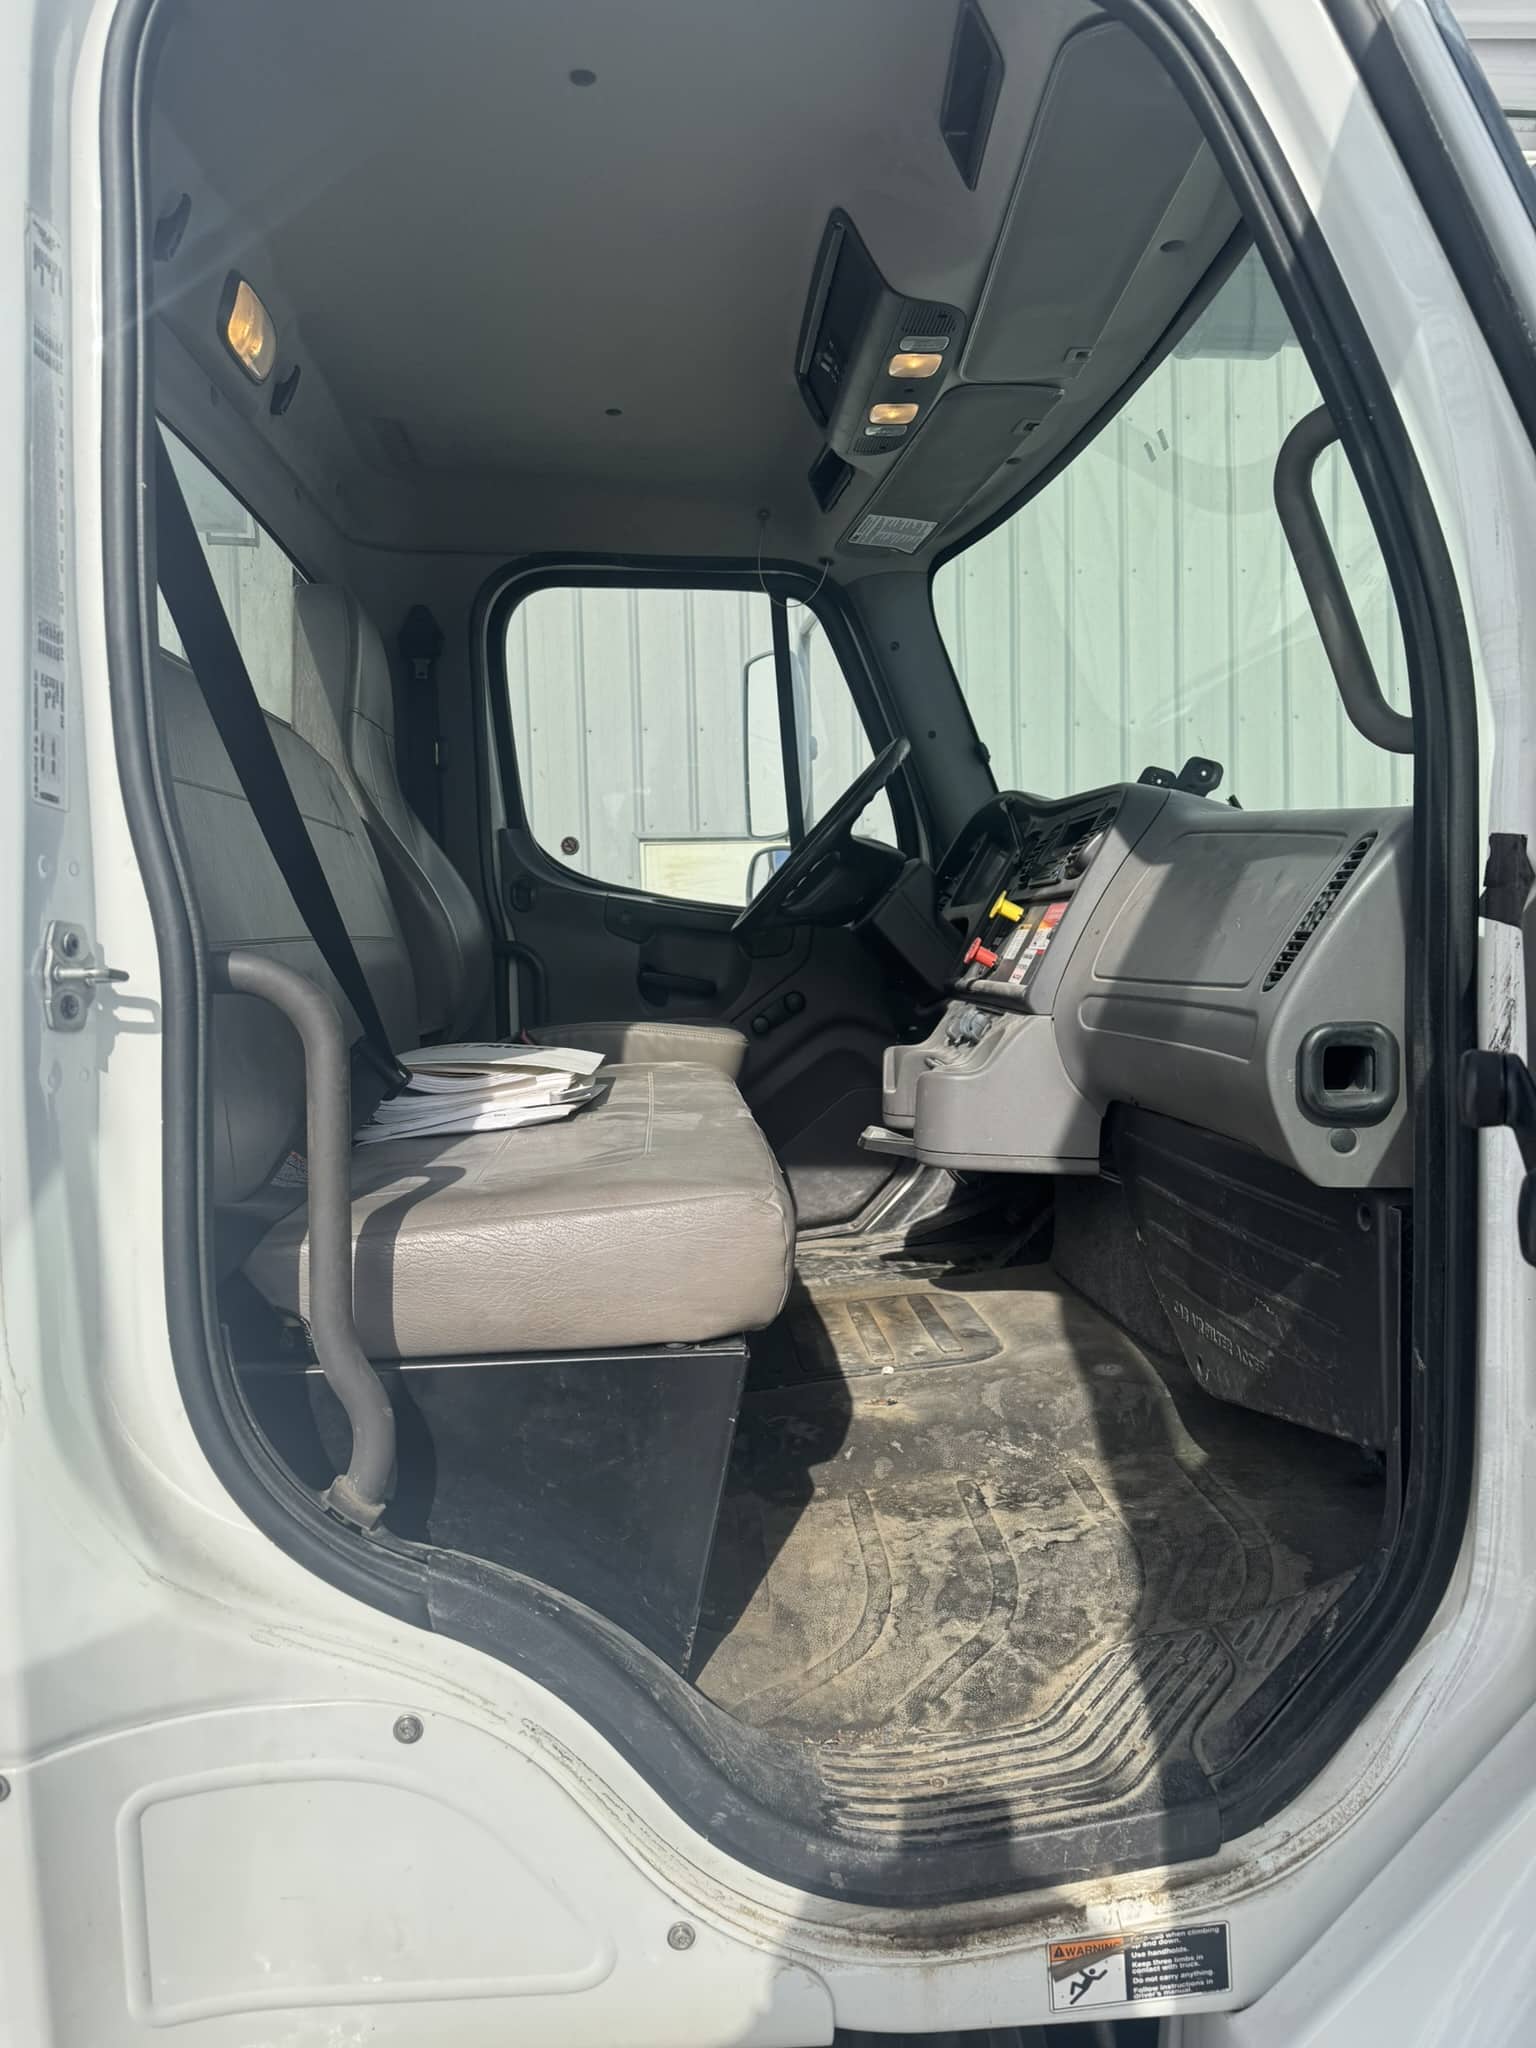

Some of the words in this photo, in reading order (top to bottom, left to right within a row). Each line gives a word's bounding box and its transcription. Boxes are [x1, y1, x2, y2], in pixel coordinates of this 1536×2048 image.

[1165, 1930, 1186, 1938] when
[1187, 1927, 1220, 1936] climbing
[1142, 1939, 1157, 1947] and
[1065, 1943, 1119, 1956] WARNIN
[1131, 1951, 1146, 1959] Use
[1147, 1947, 1189, 1956] handholds.
[1131, 1960, 1151, 1968] Keep
[1174, 1955, 1195, 1963] limbs
[1131, 1965, 1161, 1974] contact
[1159, 1973, 1179, 1981] carry
[1133, 1985, 1158, 1993] Follow
[1159, 1980, 1204, 1990] instructions
[1133, 1991, 1162, 1999] driver's
